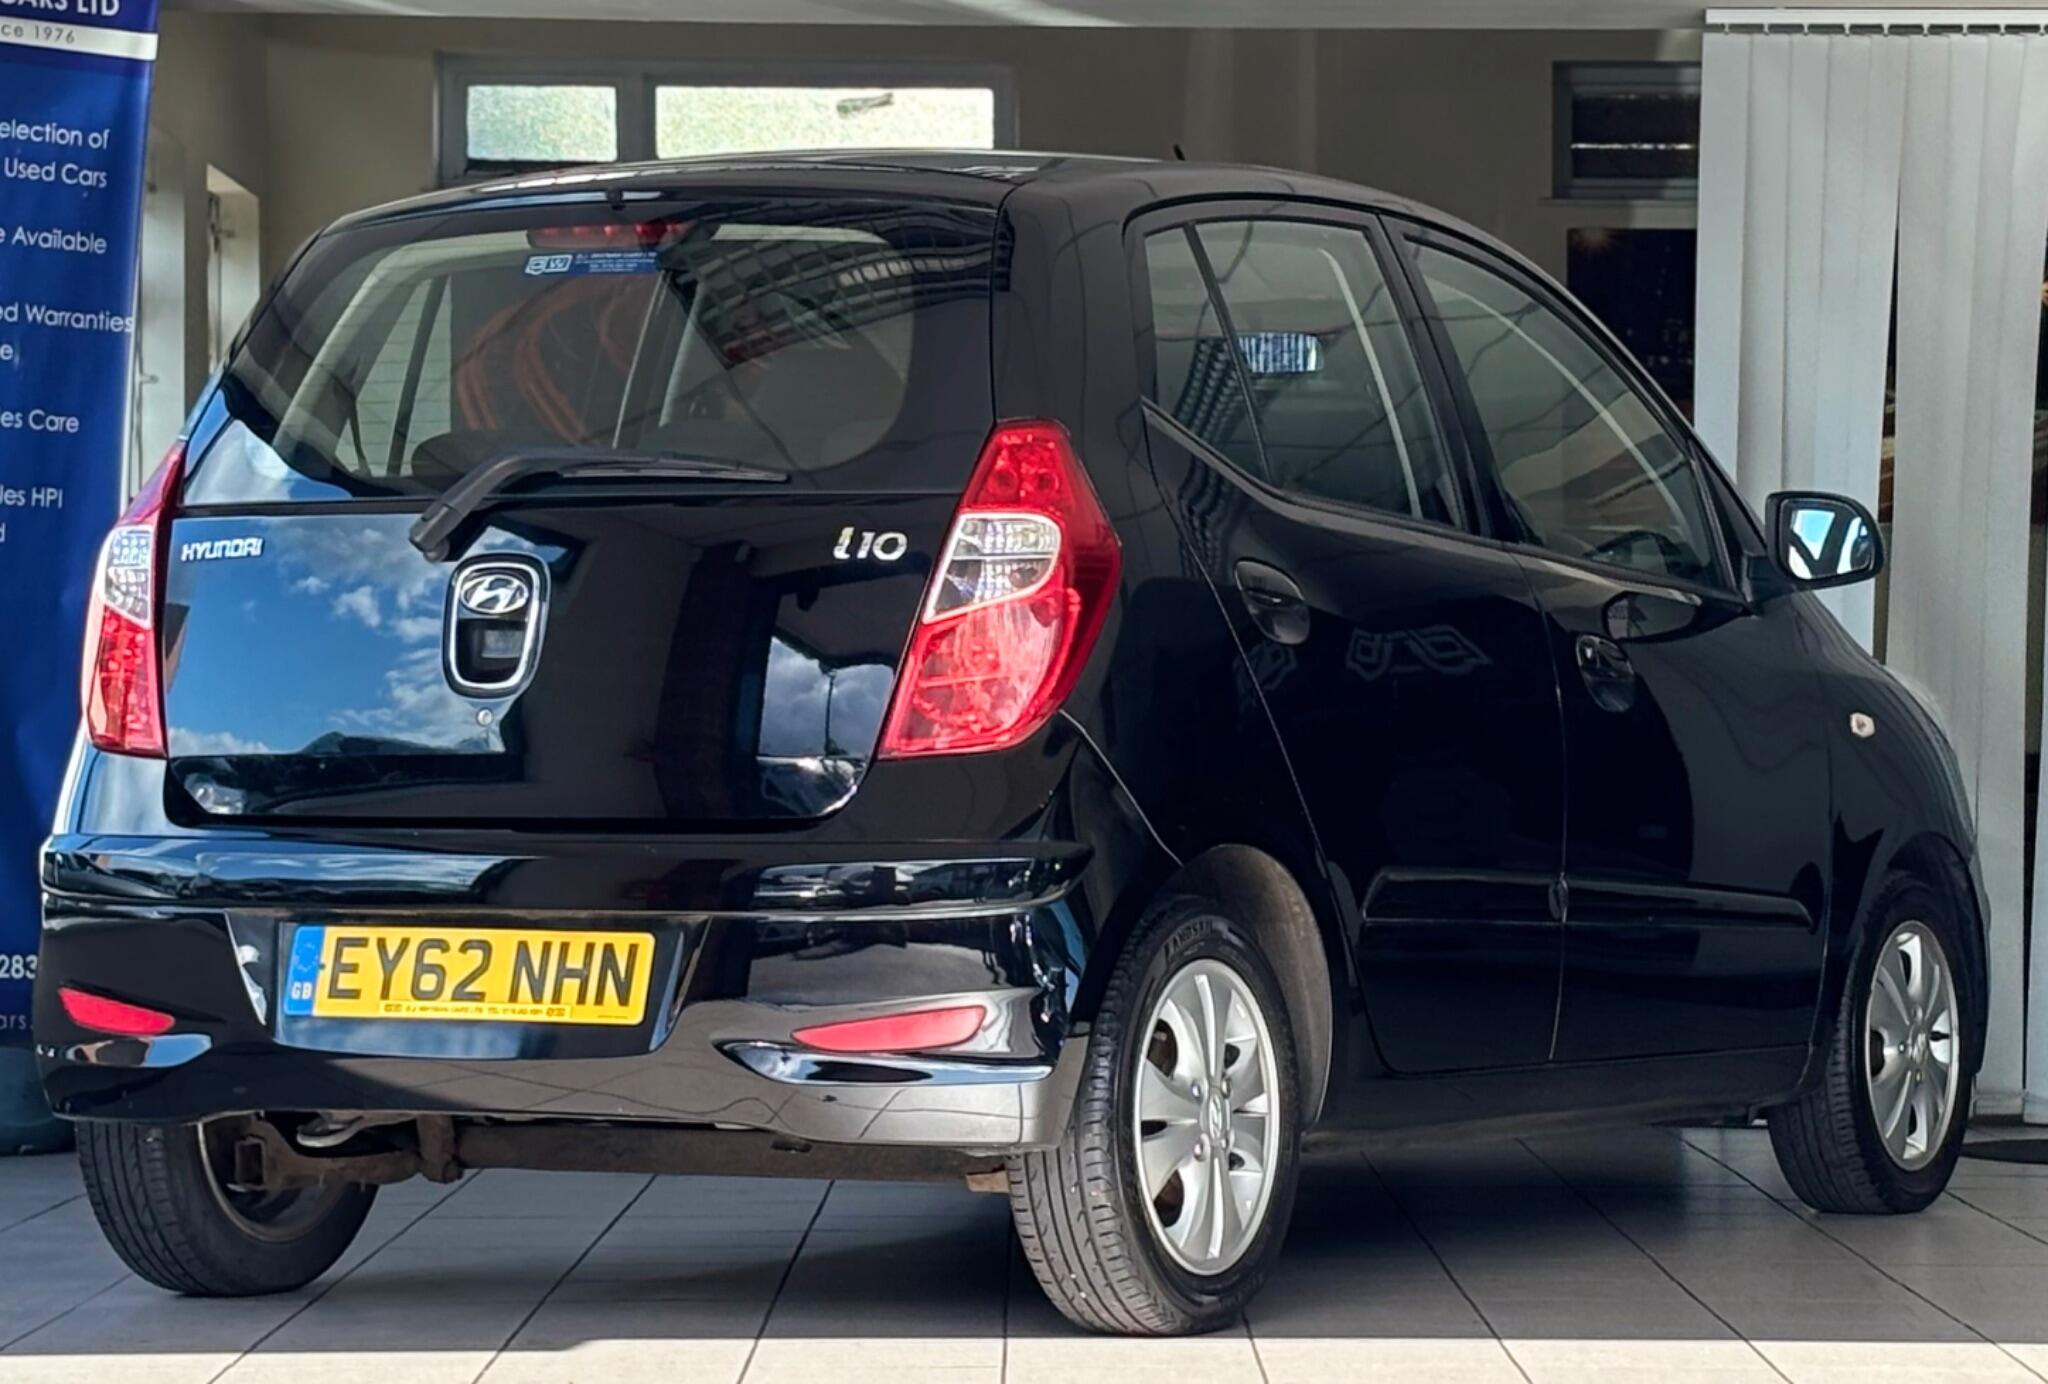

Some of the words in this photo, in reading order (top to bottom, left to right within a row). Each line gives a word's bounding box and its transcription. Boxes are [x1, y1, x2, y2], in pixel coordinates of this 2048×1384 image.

[34, 25, 75, 44] 1976
[0, 119, 82, 147] election
[88, 129, 111, 149] of
[4, 157, 56, 182] Used
[61, 163, 107, 188] Cars
[11, 226, 107, 254] Available
[25, 303, 134, 333] Warranties
[0, 411, 23, 429] es
[28, 409, 80, 433] Care
[31, 487, 63, 509] HPI
[181, 537, 263, 561] HYUNDAI
[0, 954, 38, 979] 283
[327, 937, 492, 1001] EY62
[508, 940, 639, 1007] NHN
[291, 981, 313, 1000] GB
